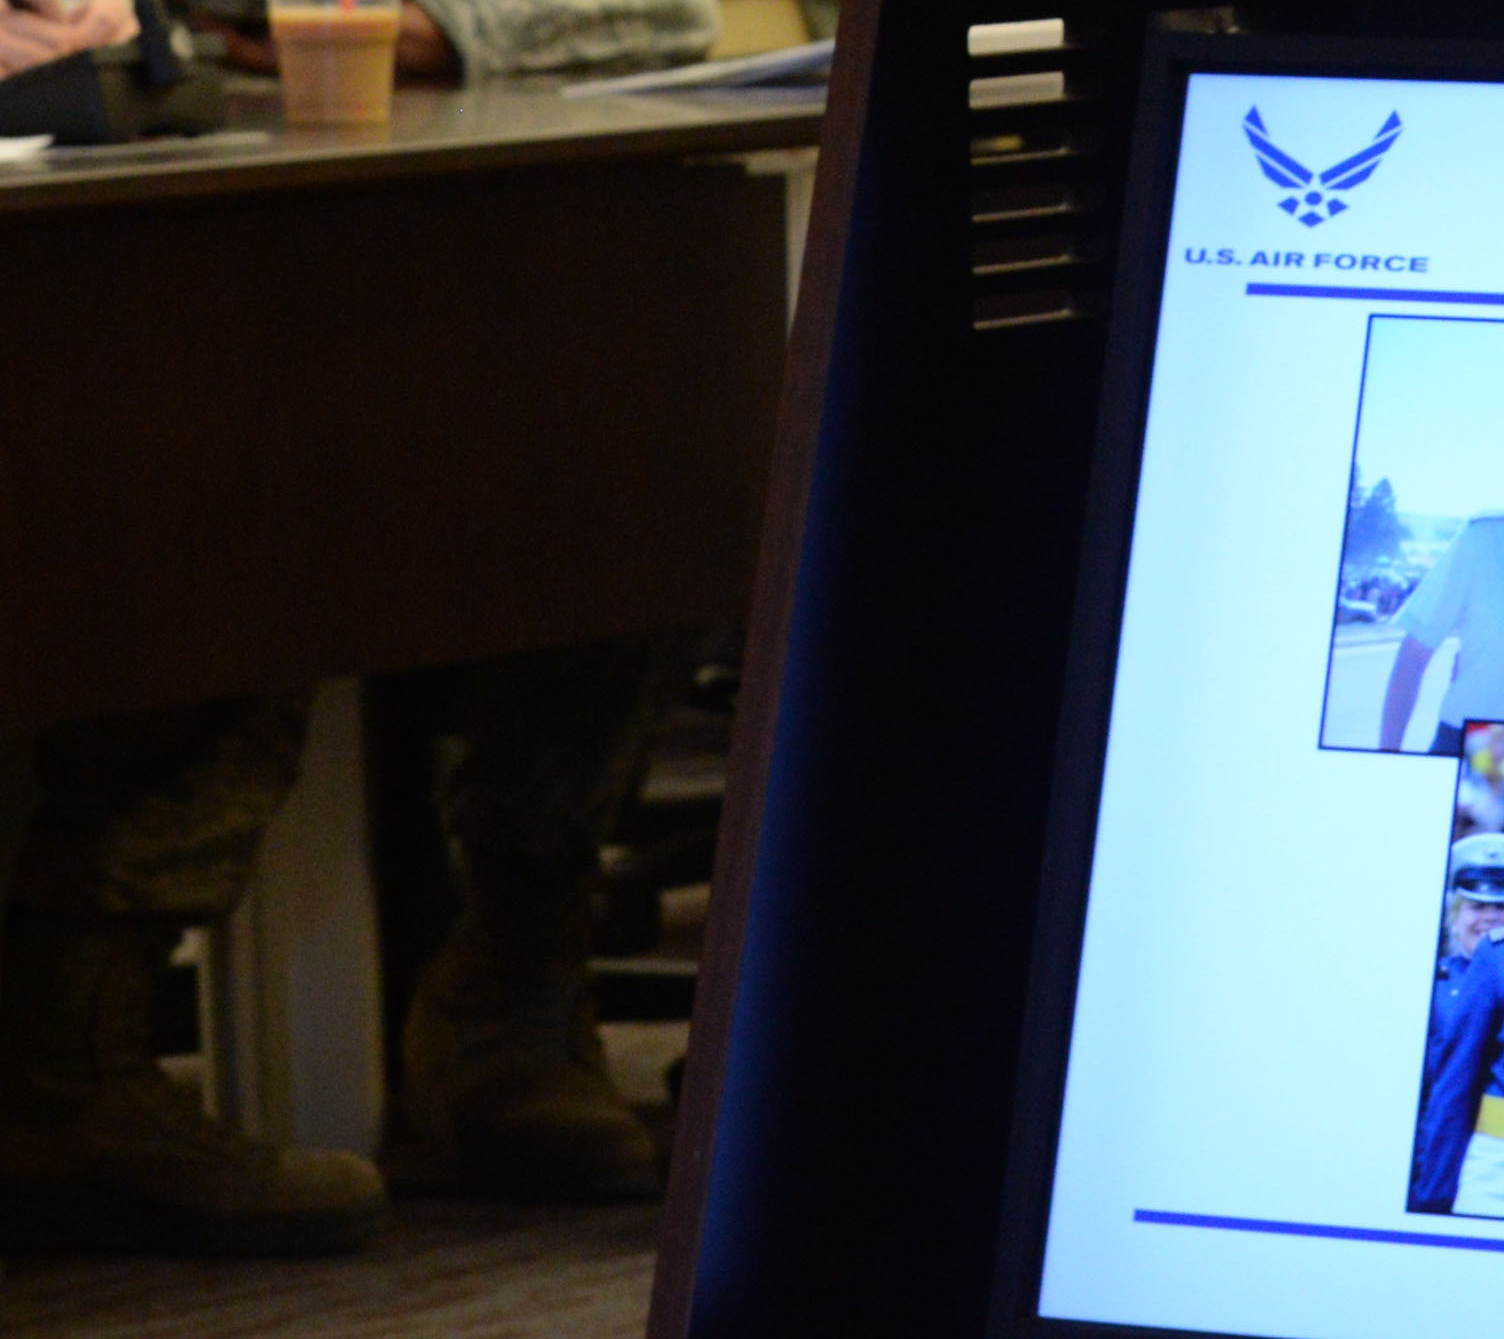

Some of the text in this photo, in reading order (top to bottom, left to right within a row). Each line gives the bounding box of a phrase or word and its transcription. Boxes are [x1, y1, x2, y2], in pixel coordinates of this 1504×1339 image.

[1183, 247, 1430, 273] U.S. AIR FORCE
